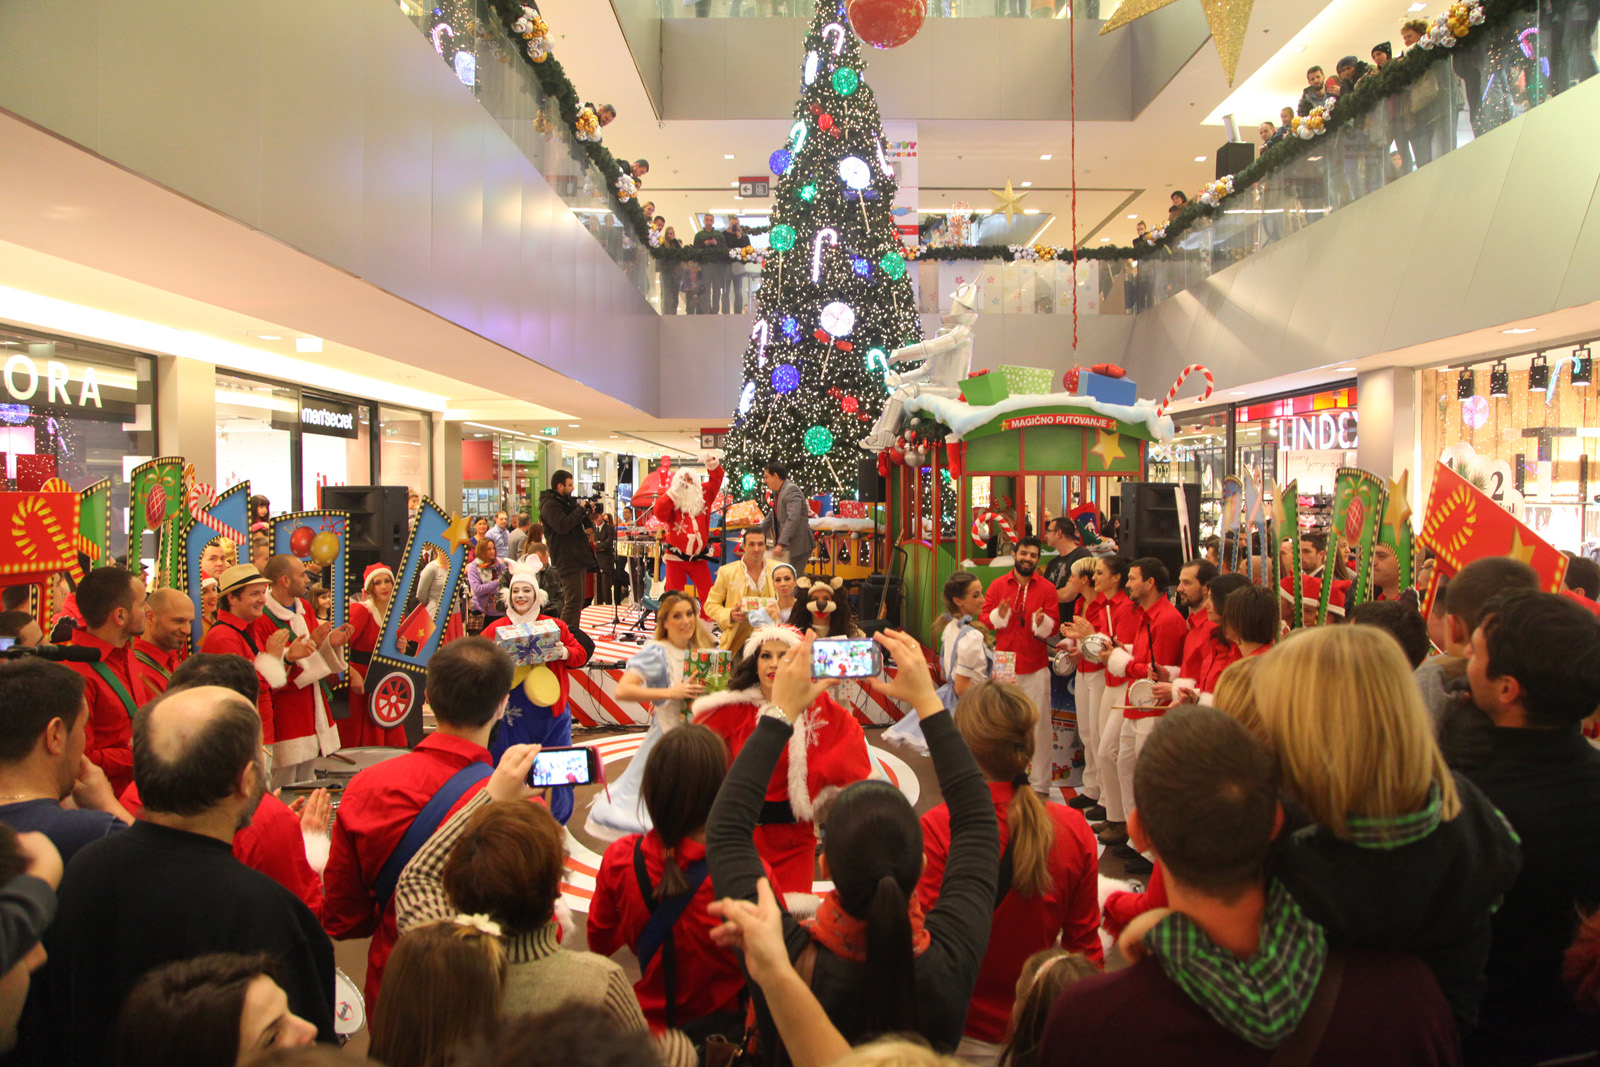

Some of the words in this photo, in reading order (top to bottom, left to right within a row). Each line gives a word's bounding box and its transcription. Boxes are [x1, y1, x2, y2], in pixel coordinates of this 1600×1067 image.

[302, 407, 353, 430] men'secret
[1011, 416, 1054, 428] MAGIČNO
[1056, 416, 1108, 427] PUTOVANJE
[1490, 471, 1504, 501] 2
